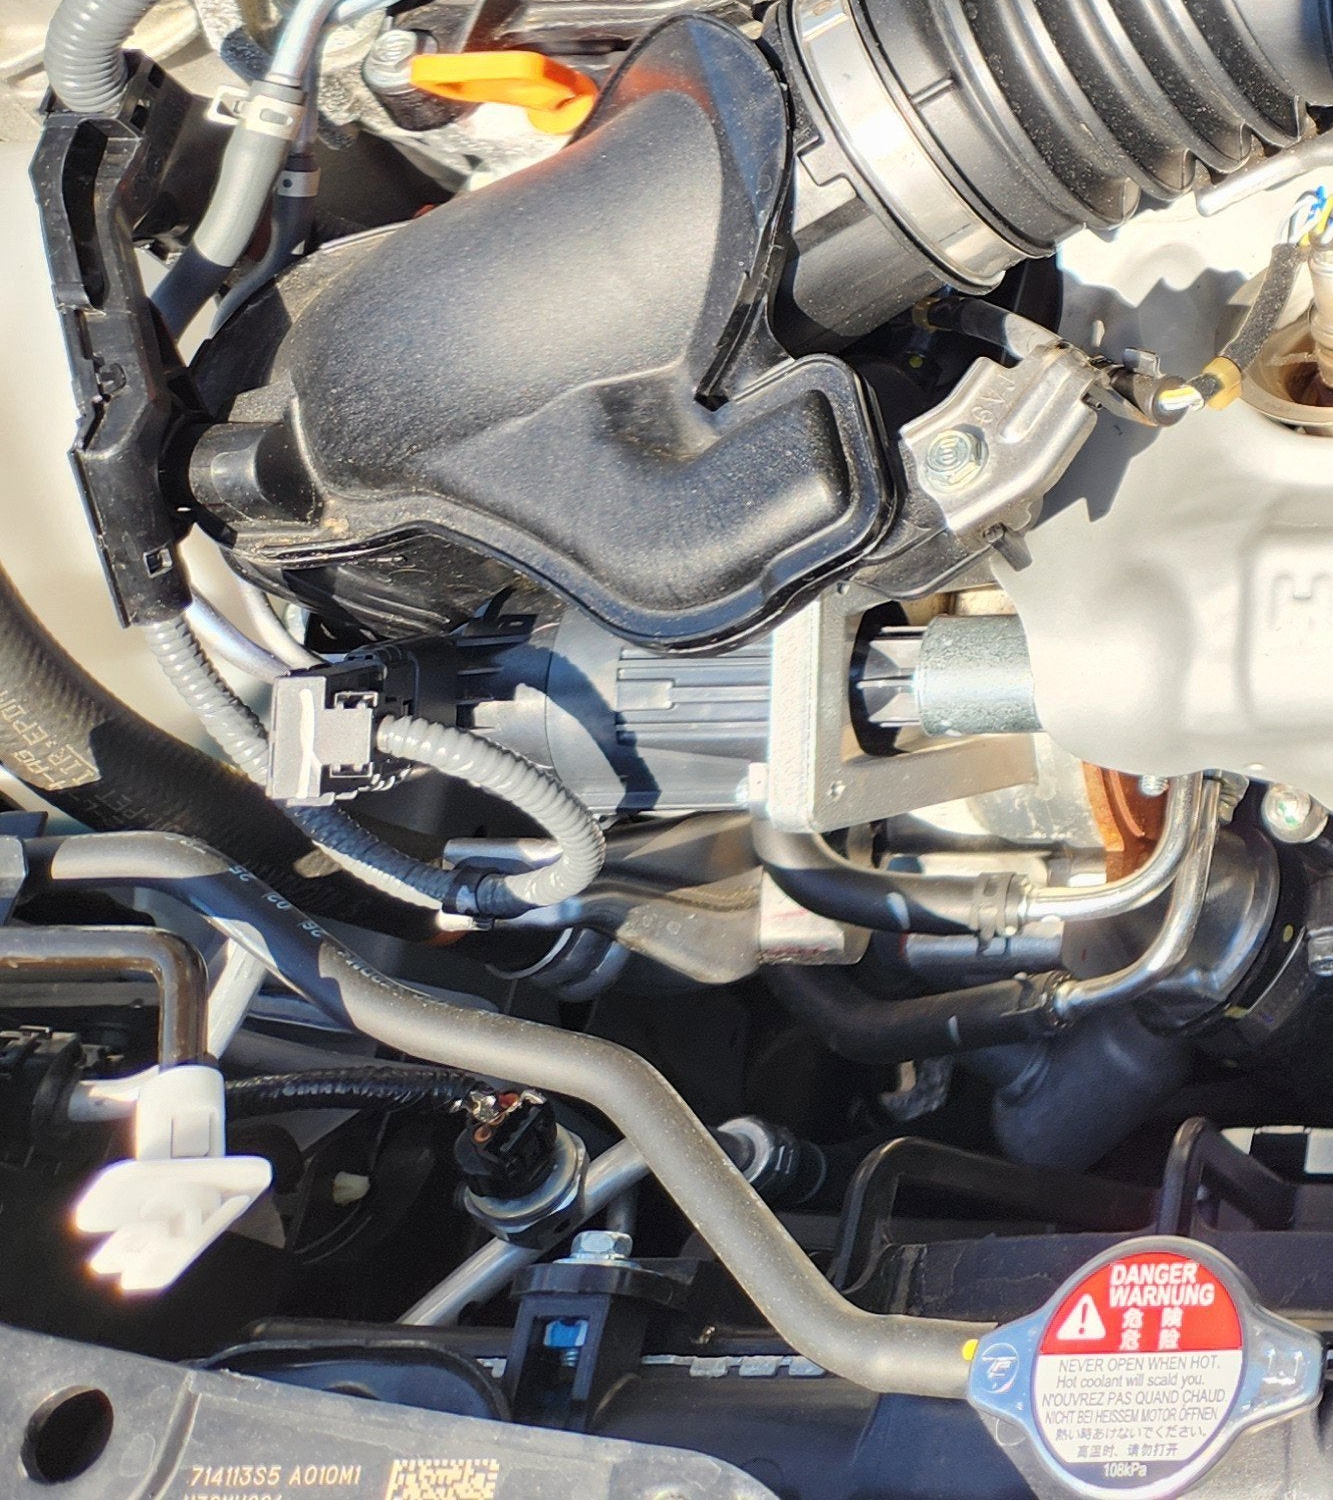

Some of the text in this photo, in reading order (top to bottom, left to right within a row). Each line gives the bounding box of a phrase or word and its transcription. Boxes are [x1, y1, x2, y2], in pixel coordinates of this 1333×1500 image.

[1110, 1263, 1198, 1286] DANGER
[1109, 1283, 1215, 1307] WARNUNG
[1059, 1354, 1220, 1373] NEVER OPEN WHEN HOT.
[1056, 1375, 1077, 1389] Hot
[1080, 1374, 1123, 1388] coolant
[1126, 1373, 1144, 1387] will
[1181, 1374, 1205, 1390] you.
[1041, 1392, 1105, 1407] N'OUVREZ
[1107, 1391, 1132, 1406] PAS
[1135, 1390, 1179, 1406] QUAND
[1045, 1410, 1075, 1425] NICHT
[1077, 1410, 1093, 1424] BEI
[1095, 1408, 1139, 1424] HEISSEM
[1141, 1407, 1177, 1422] MOTOR
[190, 1465, 282, 1487] 714113S5
[1103, 1462, 1148, 1478] 108kPa
